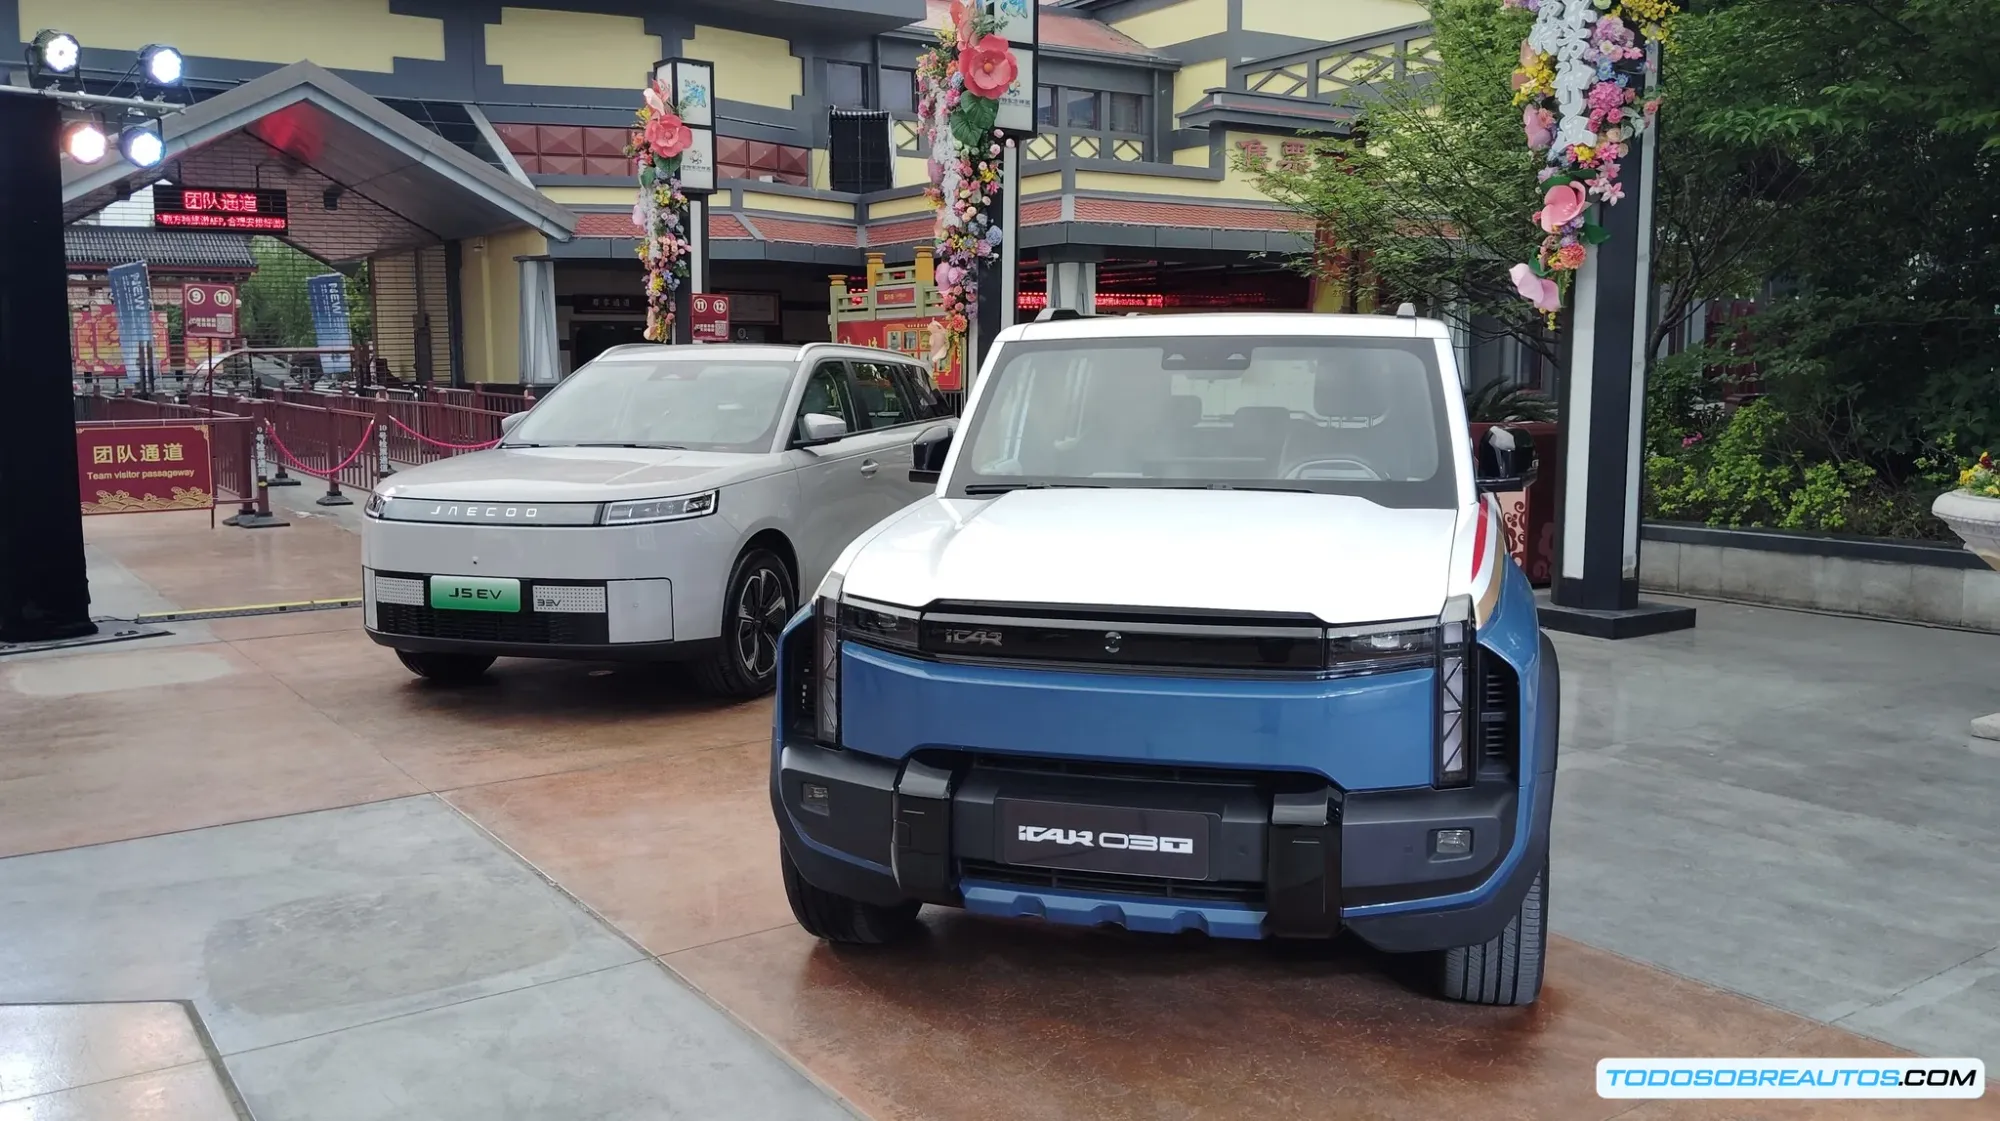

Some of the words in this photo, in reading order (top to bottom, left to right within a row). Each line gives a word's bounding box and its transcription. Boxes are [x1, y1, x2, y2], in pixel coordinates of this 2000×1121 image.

[184, 191, 258, 212] 团队通道
[192, 290, 201, 302] 9
[217, 292, 230, 304] 10
[696, 300, 704, 310] 11
[715, 301, 724, 311] 12
[93, 443, 184, 464] 团队通道
[87, 470, 112, 480] Team
[114, 470, 140, 479] visitor
[142, 468, 195, 479] passageway
[430, 505, 538, 518] JAECOO
[449, 587, 473, 599] J5
[476, 589, 502, 600] EV
